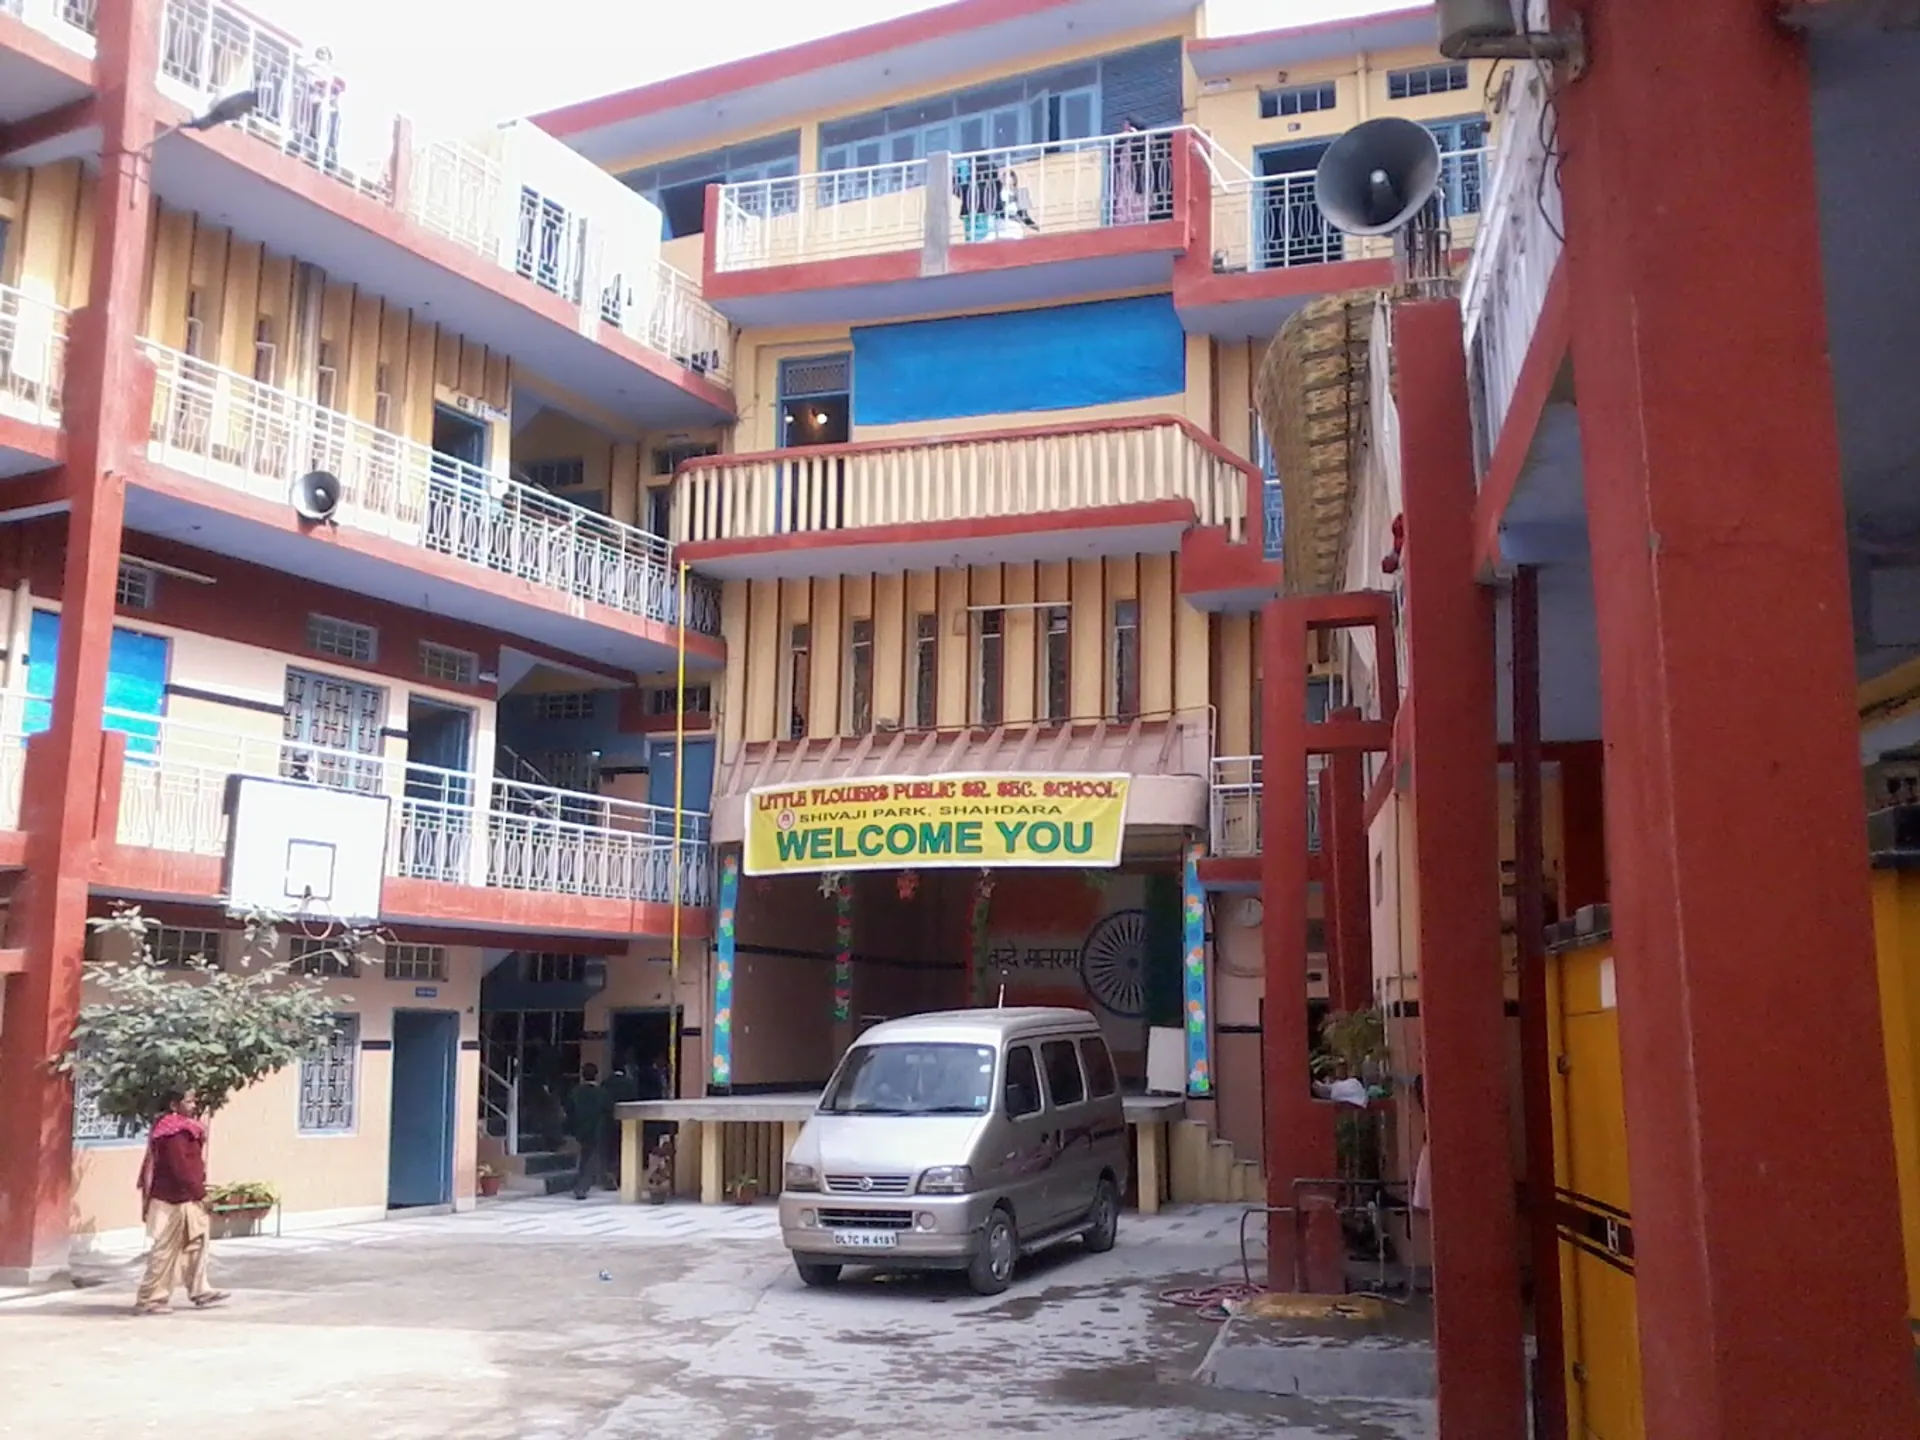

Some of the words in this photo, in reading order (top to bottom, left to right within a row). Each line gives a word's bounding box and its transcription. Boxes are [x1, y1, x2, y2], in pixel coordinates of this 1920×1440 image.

[758, 789, 807, 810] LITTLE
[811, 783, 889, 805] FLOWERS
[893, 781, 957, 800] PUBLIC
[996, 780, 1037, 798] SEC.
[1043, 780, 1119, 798] SCHOOL
[799, 810, 867, 823] SHIVAJI
[937, 804, 1062, 816] SHAHDARA
[776, 822, 983, 861] WELCOME
[995, 821, 1093, 854] YOU
